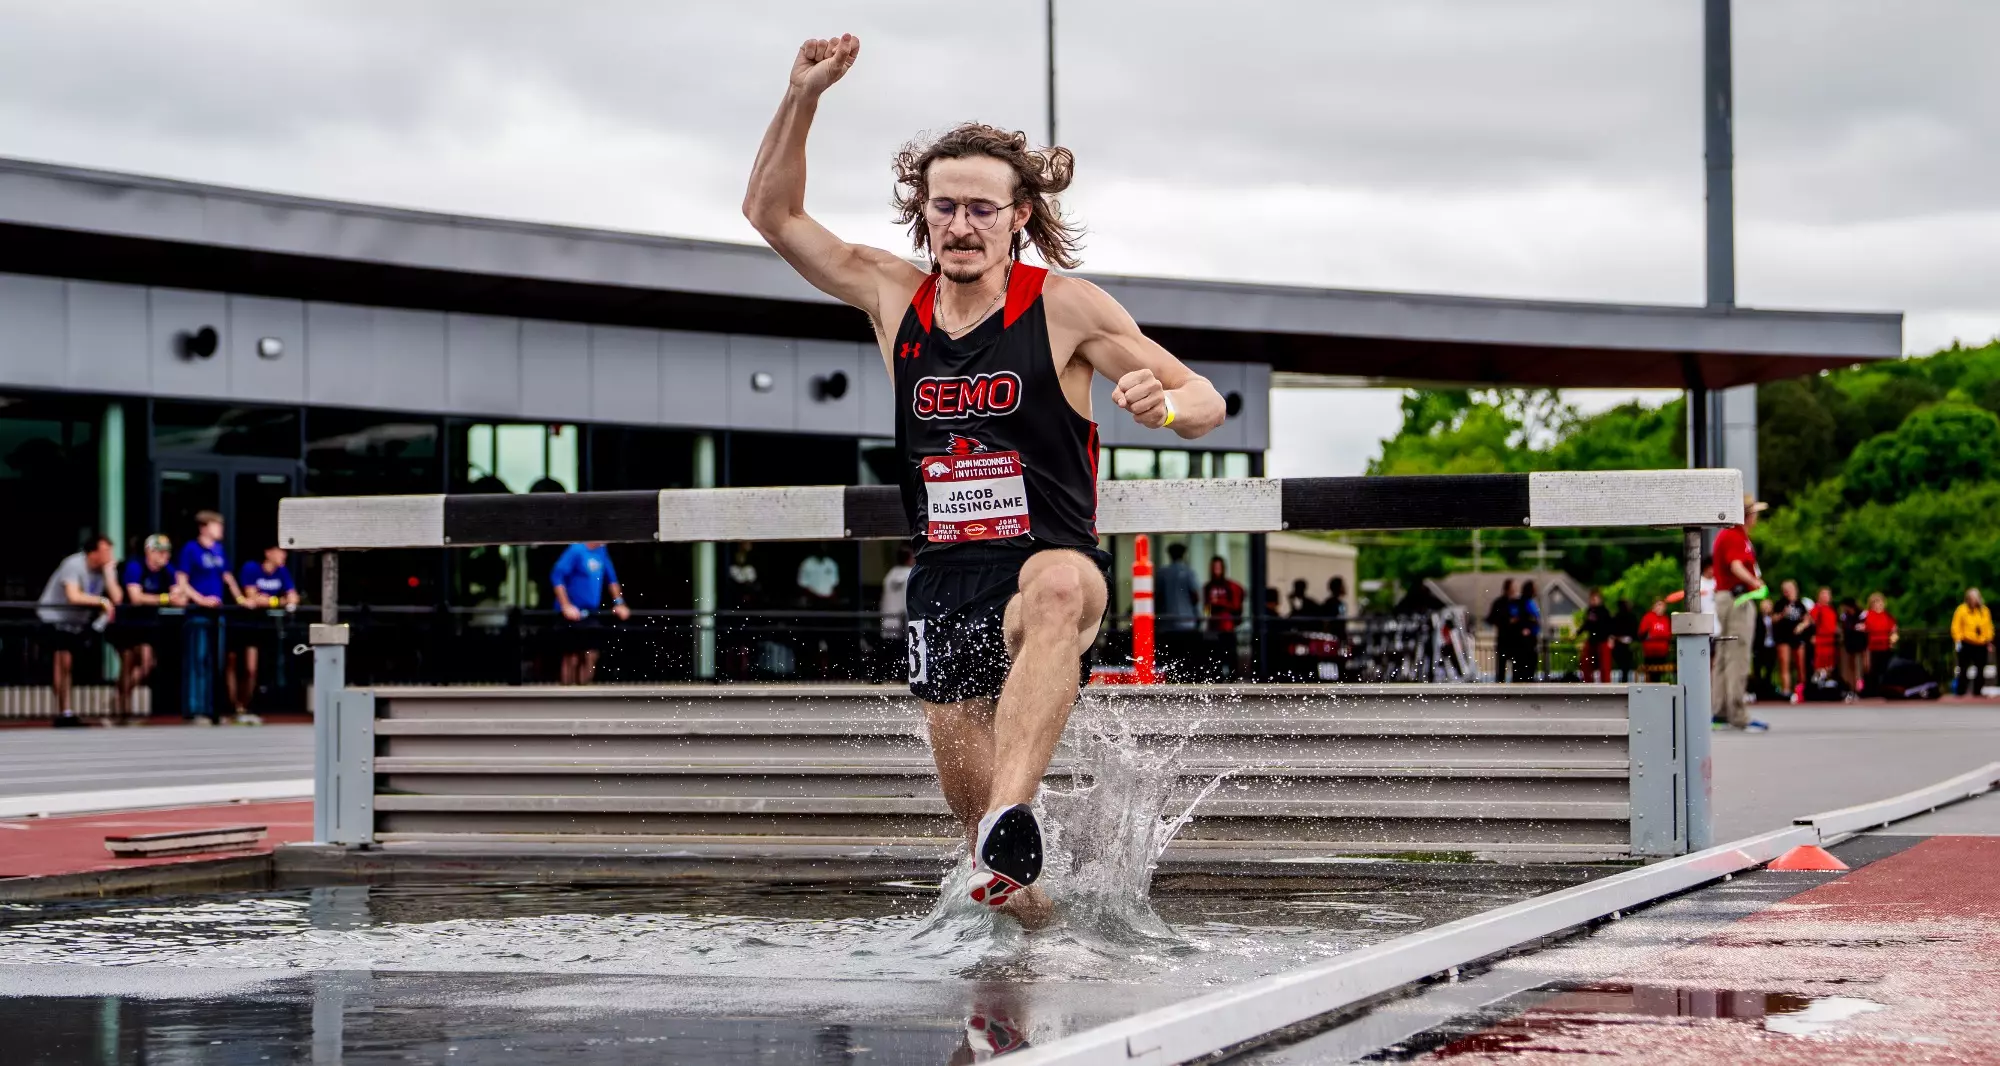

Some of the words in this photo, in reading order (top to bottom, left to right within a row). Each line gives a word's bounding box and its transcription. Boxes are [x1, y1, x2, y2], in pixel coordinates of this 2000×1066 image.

[915, 374, 1019, 417] SEMO
[954, 460, 972, 469] JOHN
[973, 456, 1013, 467] MCDONNELL
[955, 465, 1015, 478] INVITATIONAL
[949, 488, 993, 501] JACOB
[933, 496, 1023, 513] BLASSINGAME
[998, 528, 1019, 536] FIELD
